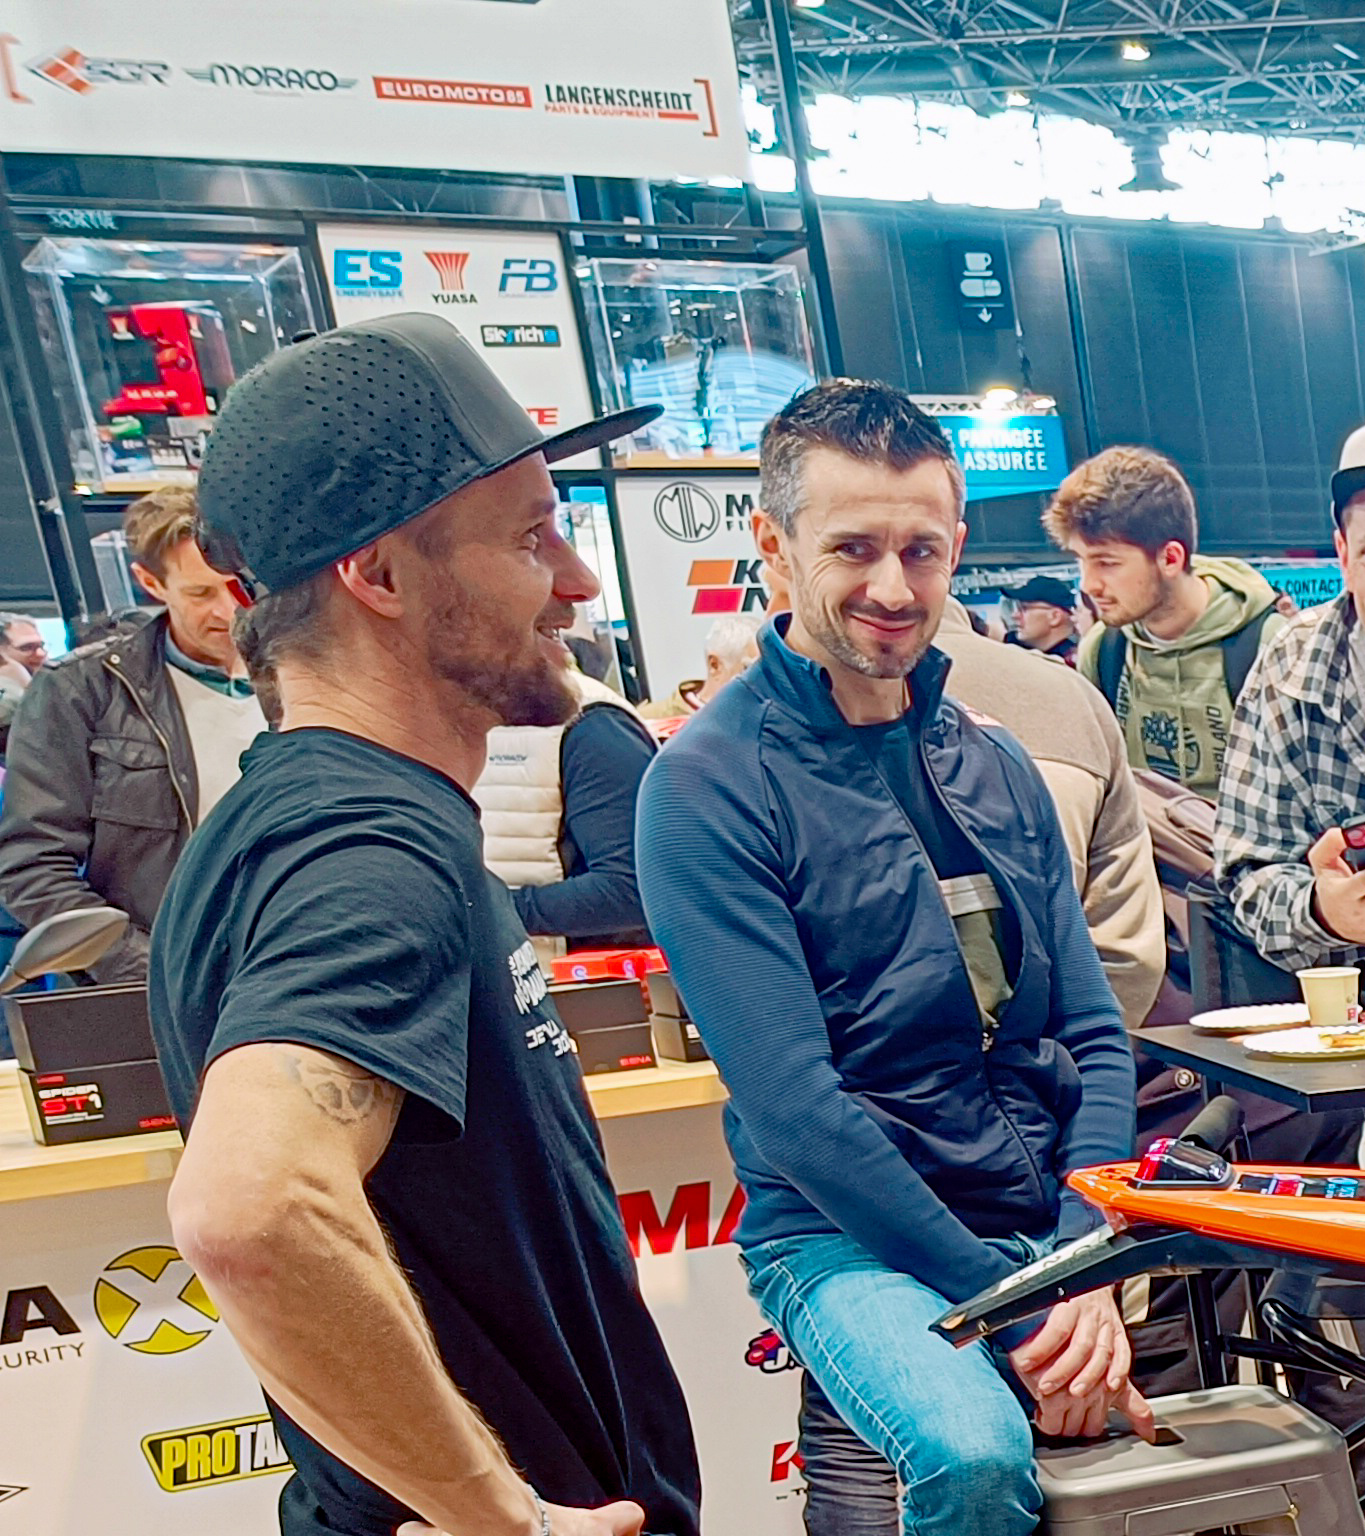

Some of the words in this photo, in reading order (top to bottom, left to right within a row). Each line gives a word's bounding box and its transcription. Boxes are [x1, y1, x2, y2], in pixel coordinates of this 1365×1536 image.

[208, 63, 340, 91] MORACO
[545, 84, 693, 111] LANGENSCHEIDT
[333, 249, 403, 289] ES
[499, 258, 559, 292] FB
[432, 293, 478, 305] YUASA
[963, 449, 1049, 472] ASSURÉE
[1285, 578, 1343, 595] CONTACT
[38, 1083, 99, 1100] SPIDER
[41, 1094, 103, 1115] ST1
[0, 1341, 86, 1371] URITY
